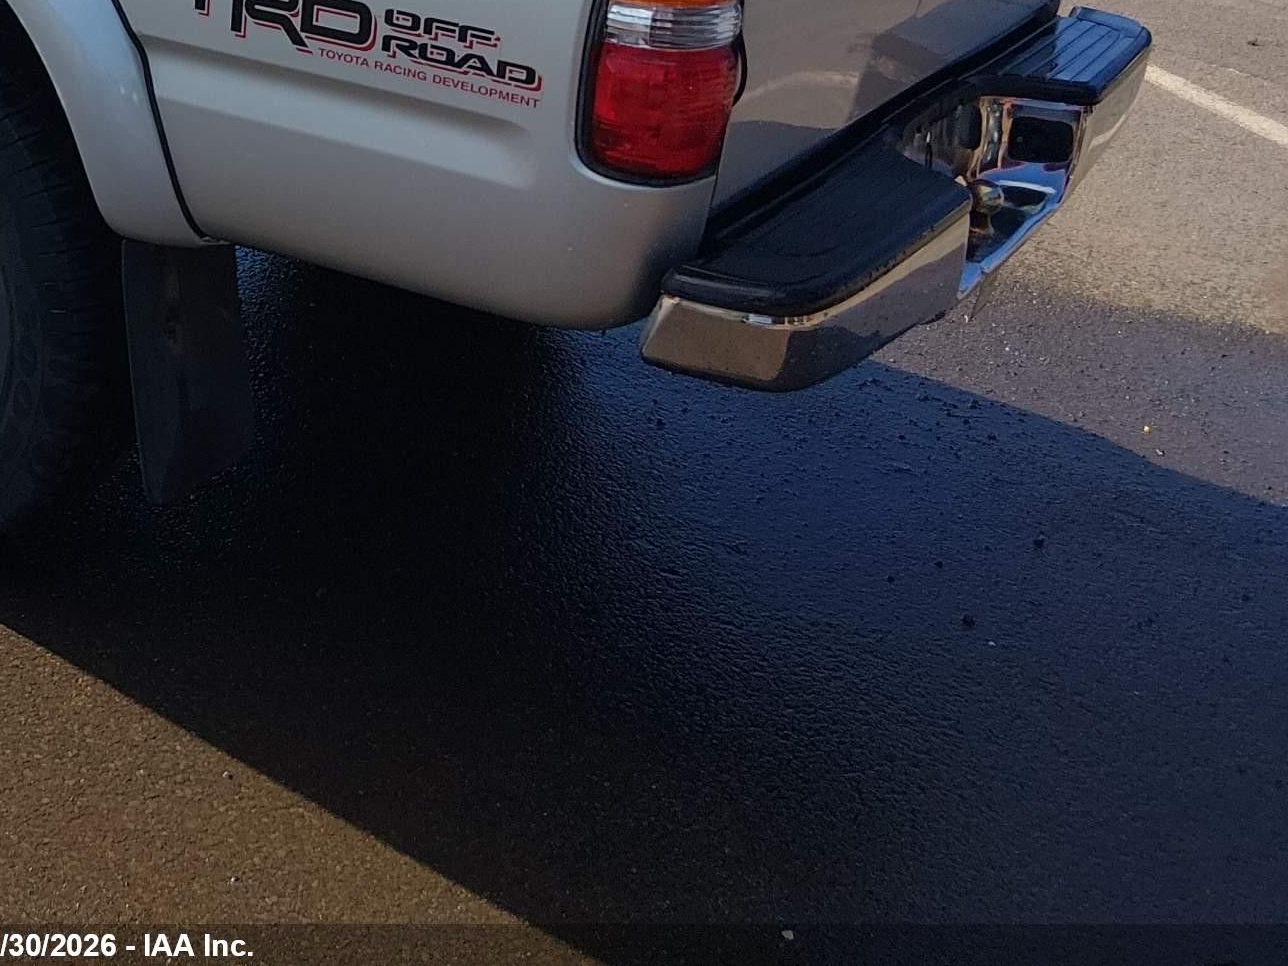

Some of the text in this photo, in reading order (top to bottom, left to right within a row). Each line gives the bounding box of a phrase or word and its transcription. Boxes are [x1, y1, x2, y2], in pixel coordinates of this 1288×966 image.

[383, 7, 500, 49] OFF
[317, 47, 541, 109] TOYOTA RACING DEVELOPMENT
[381, 34, 543, 92] ROAD
